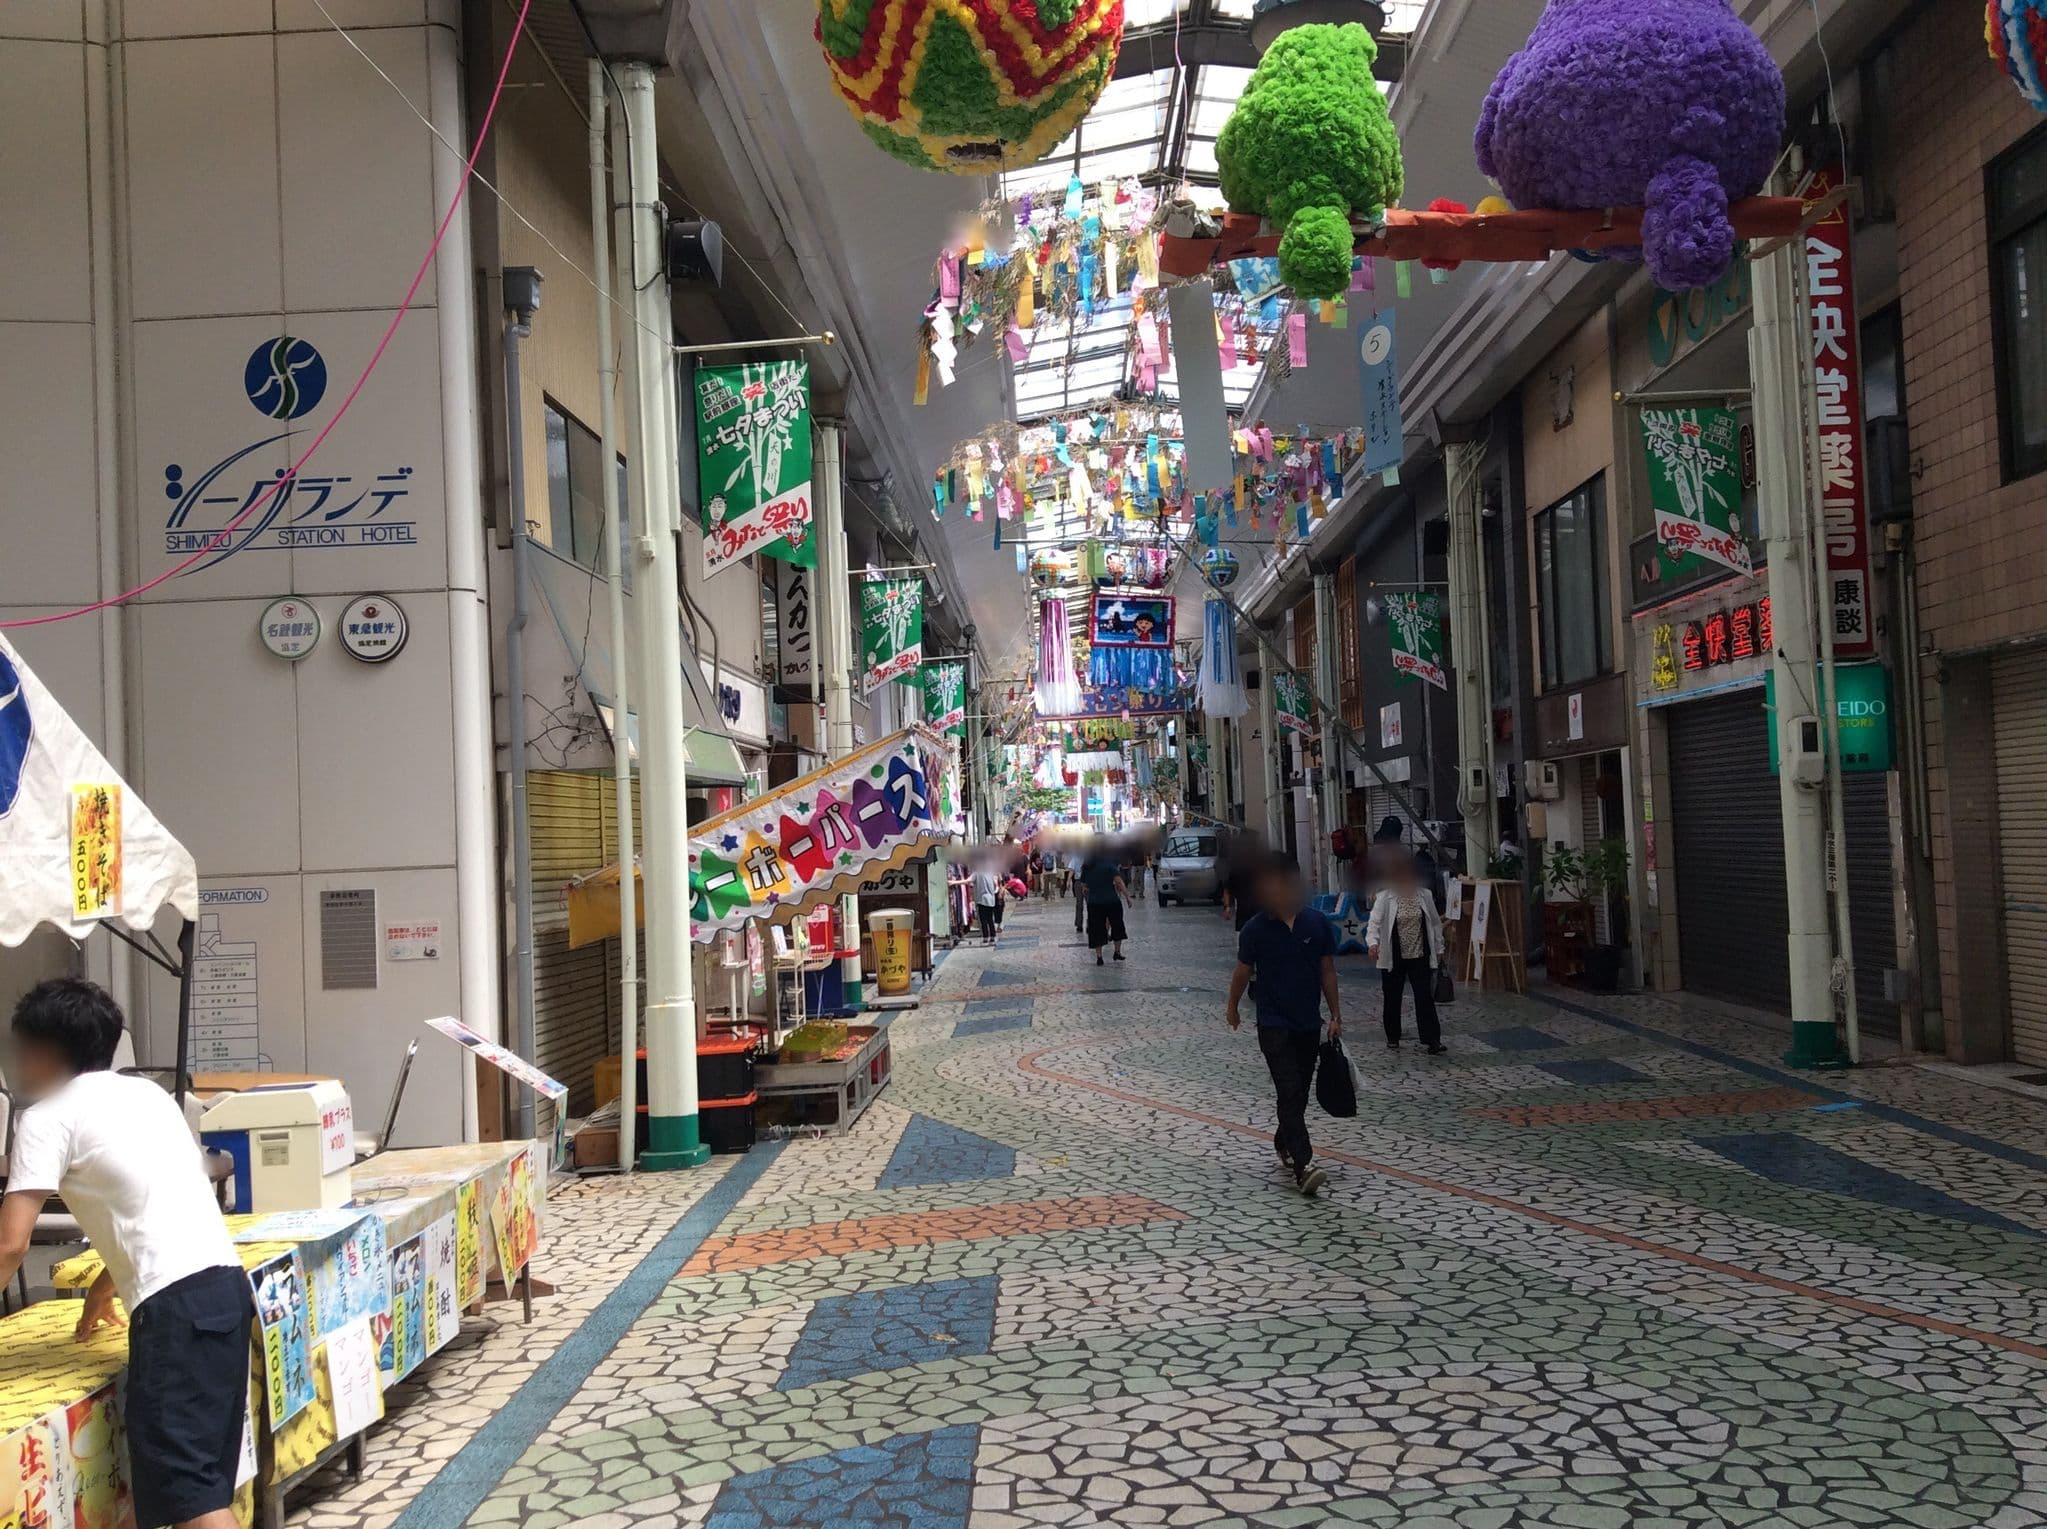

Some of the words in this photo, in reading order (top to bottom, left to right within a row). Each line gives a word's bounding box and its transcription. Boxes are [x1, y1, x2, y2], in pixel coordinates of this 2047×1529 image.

[1369, 333, 1381, 353] 5
[716, 390, 807, 444] 七夕まつり
[165, 445, 413, 535] シーグランデ
[166, 533, 232, 550] SHIMIZU
[278, 528, 345, 545] STATION
[361, 526, 416, 542] HOTEL
[722, 497, 809, 559] みなと祭り
[786, 562, 811, 653] んかつ
[1838, 701, 1886, 716] EIDO
[198, 890, 262, 903] FORMATION
[346, 1239, 358, 1277] いちご
[361, 1234, 371, 1273] メロン
[282, 1262, 305, 1398] ラムネ
